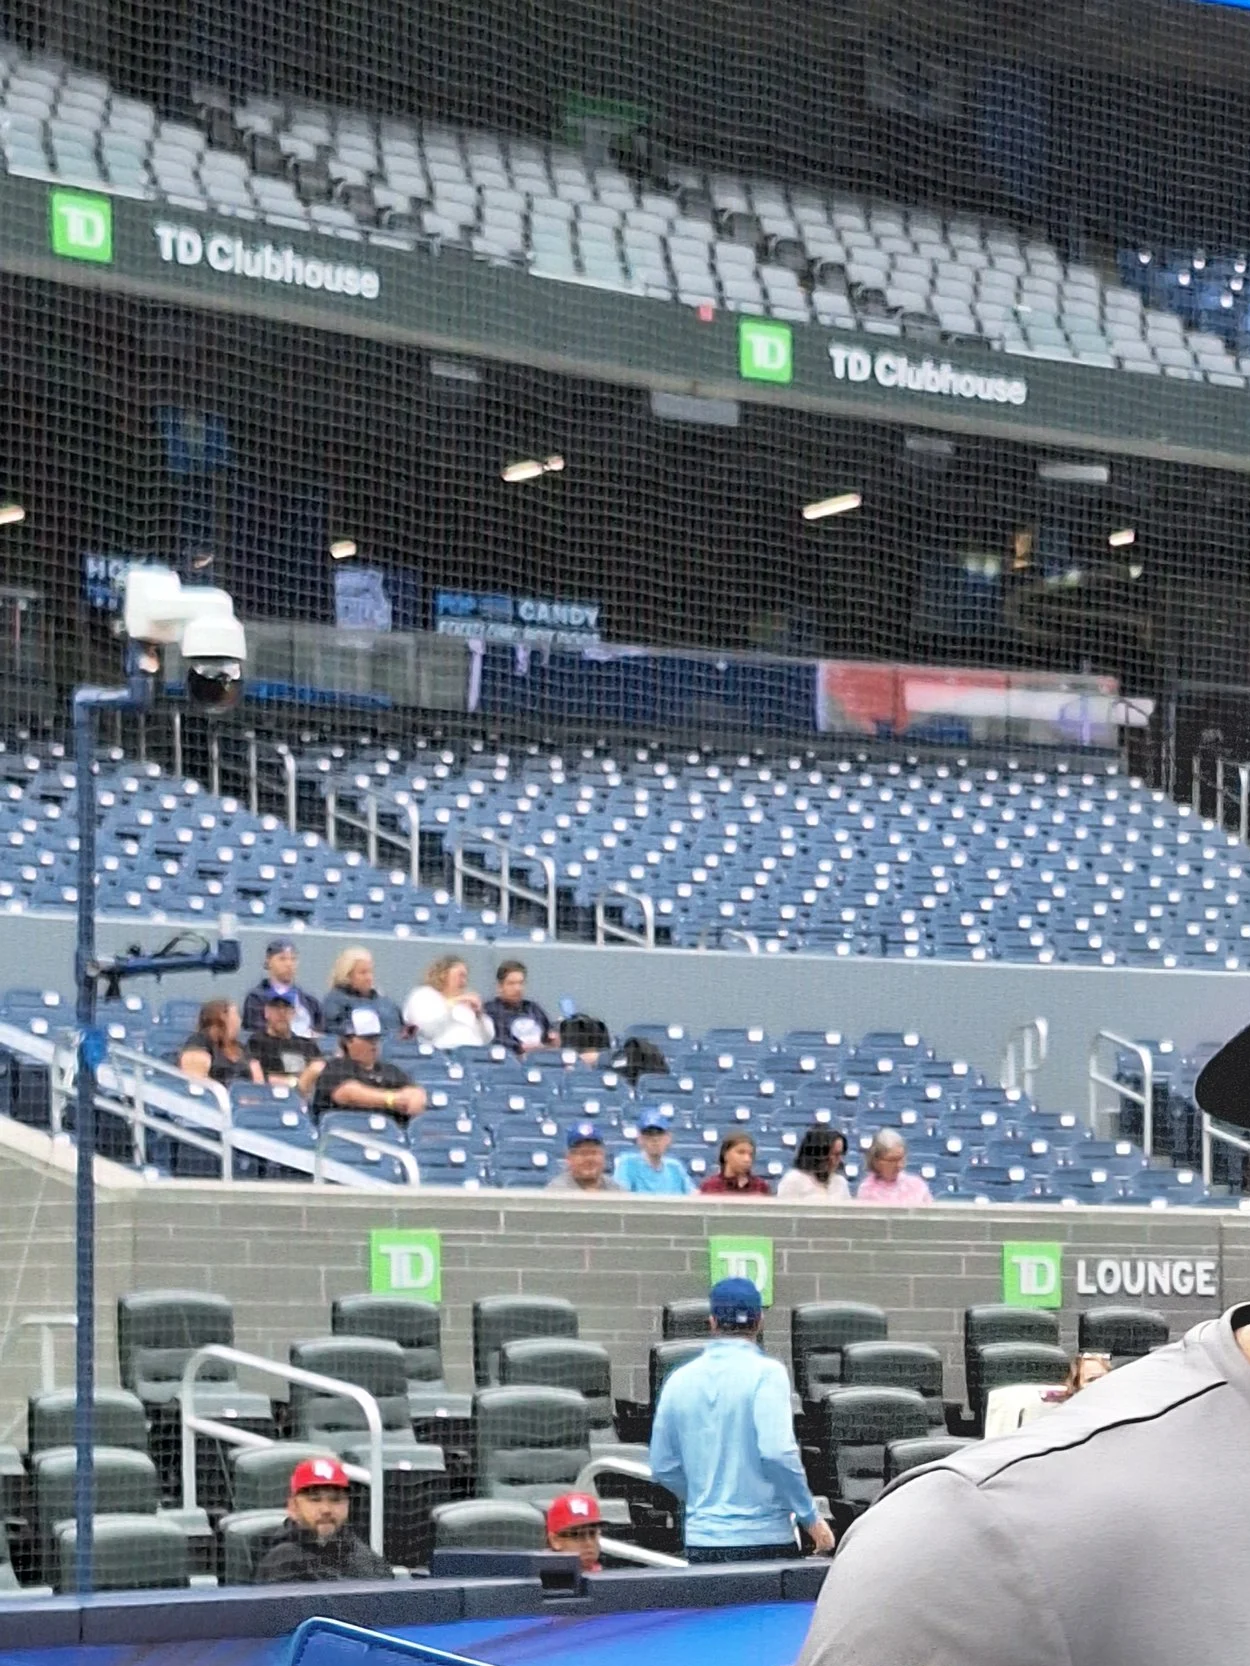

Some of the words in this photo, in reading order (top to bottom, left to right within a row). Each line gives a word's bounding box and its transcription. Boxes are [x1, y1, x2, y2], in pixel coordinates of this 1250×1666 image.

[154, 221, 203, 265] TD
[205, 232, 380, 299] Clubhouse
[828, 344, 872, 381] TD
[874, 350, 1027, 405] Clubhouse
[518, 600, 599, 628] CANDY
[379, 1244, 434, 1290] TD
[1011, 1255, 1056, 1296] TD
[1077, 1259, 1216, 1296] LOUNGE
